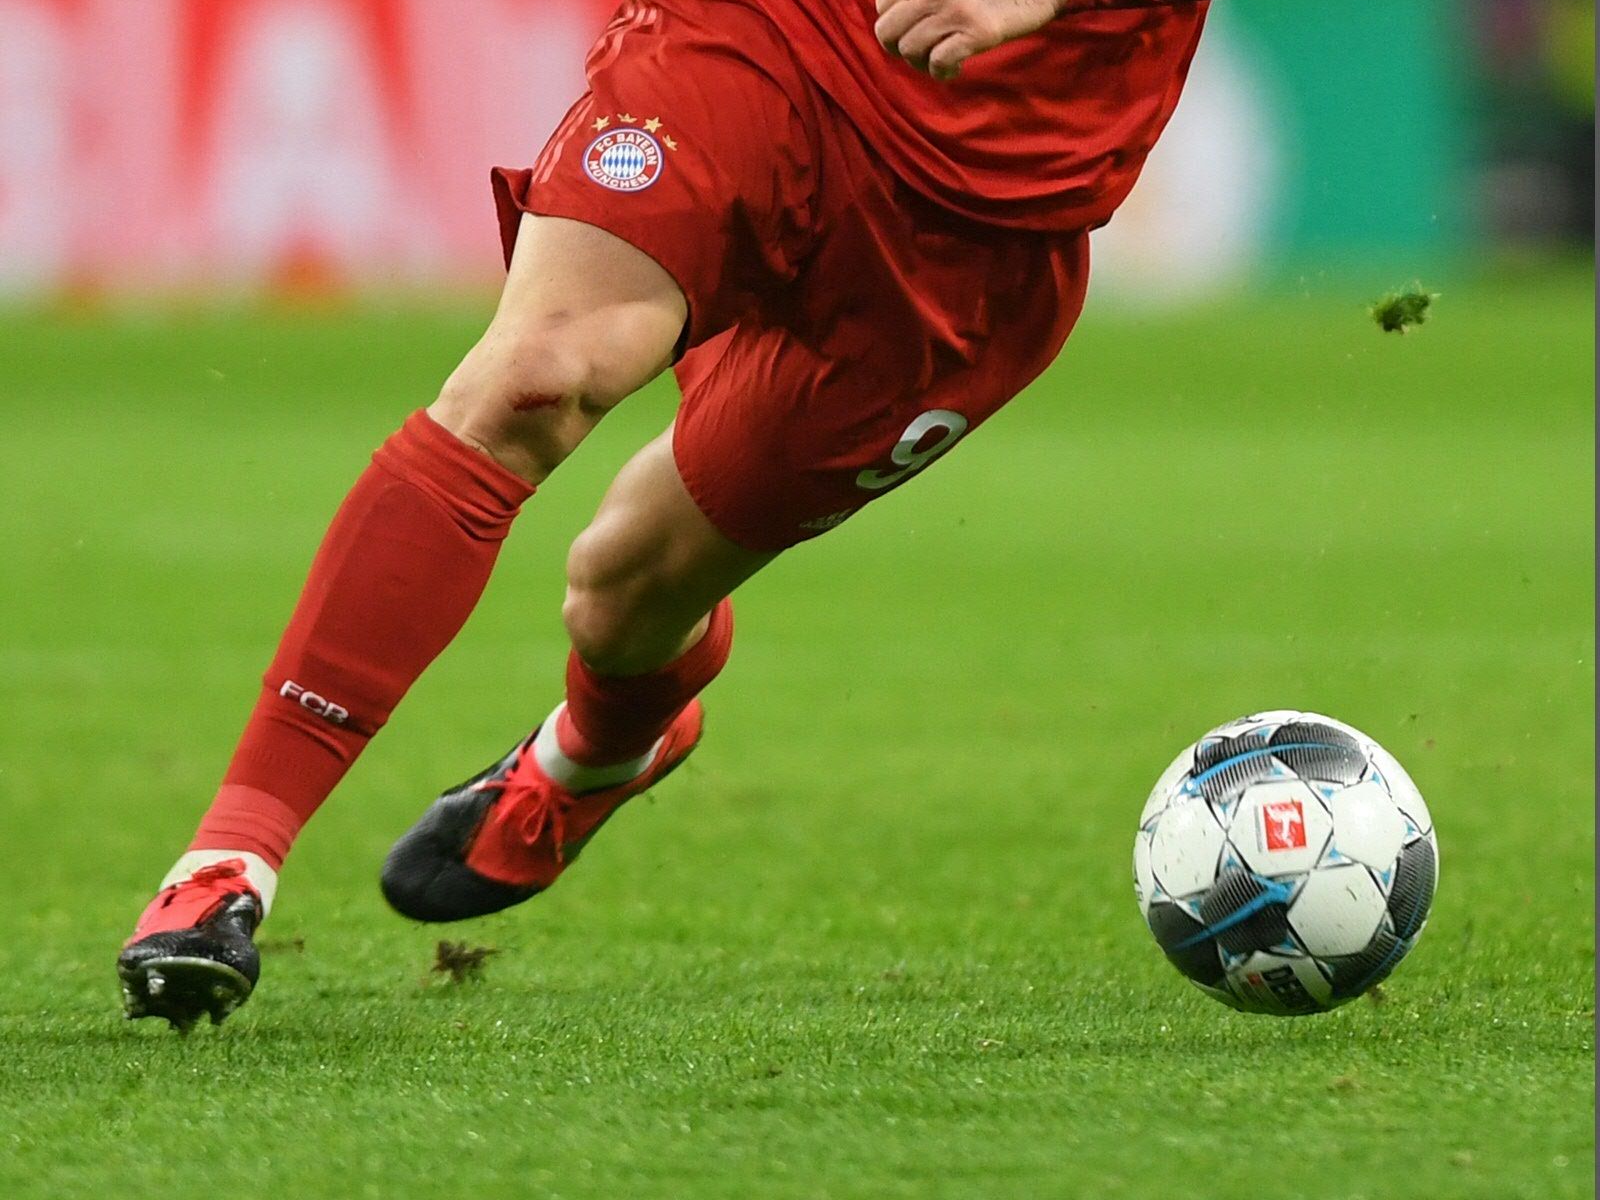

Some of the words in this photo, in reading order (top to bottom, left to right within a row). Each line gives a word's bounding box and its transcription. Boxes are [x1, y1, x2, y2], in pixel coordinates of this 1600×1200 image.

[595, 137, 614, 153] FC
[616, 133, 658, 166] BAYERN
[856, 409, 969, 490] 9
[280, 679, 349, 723] FCB
